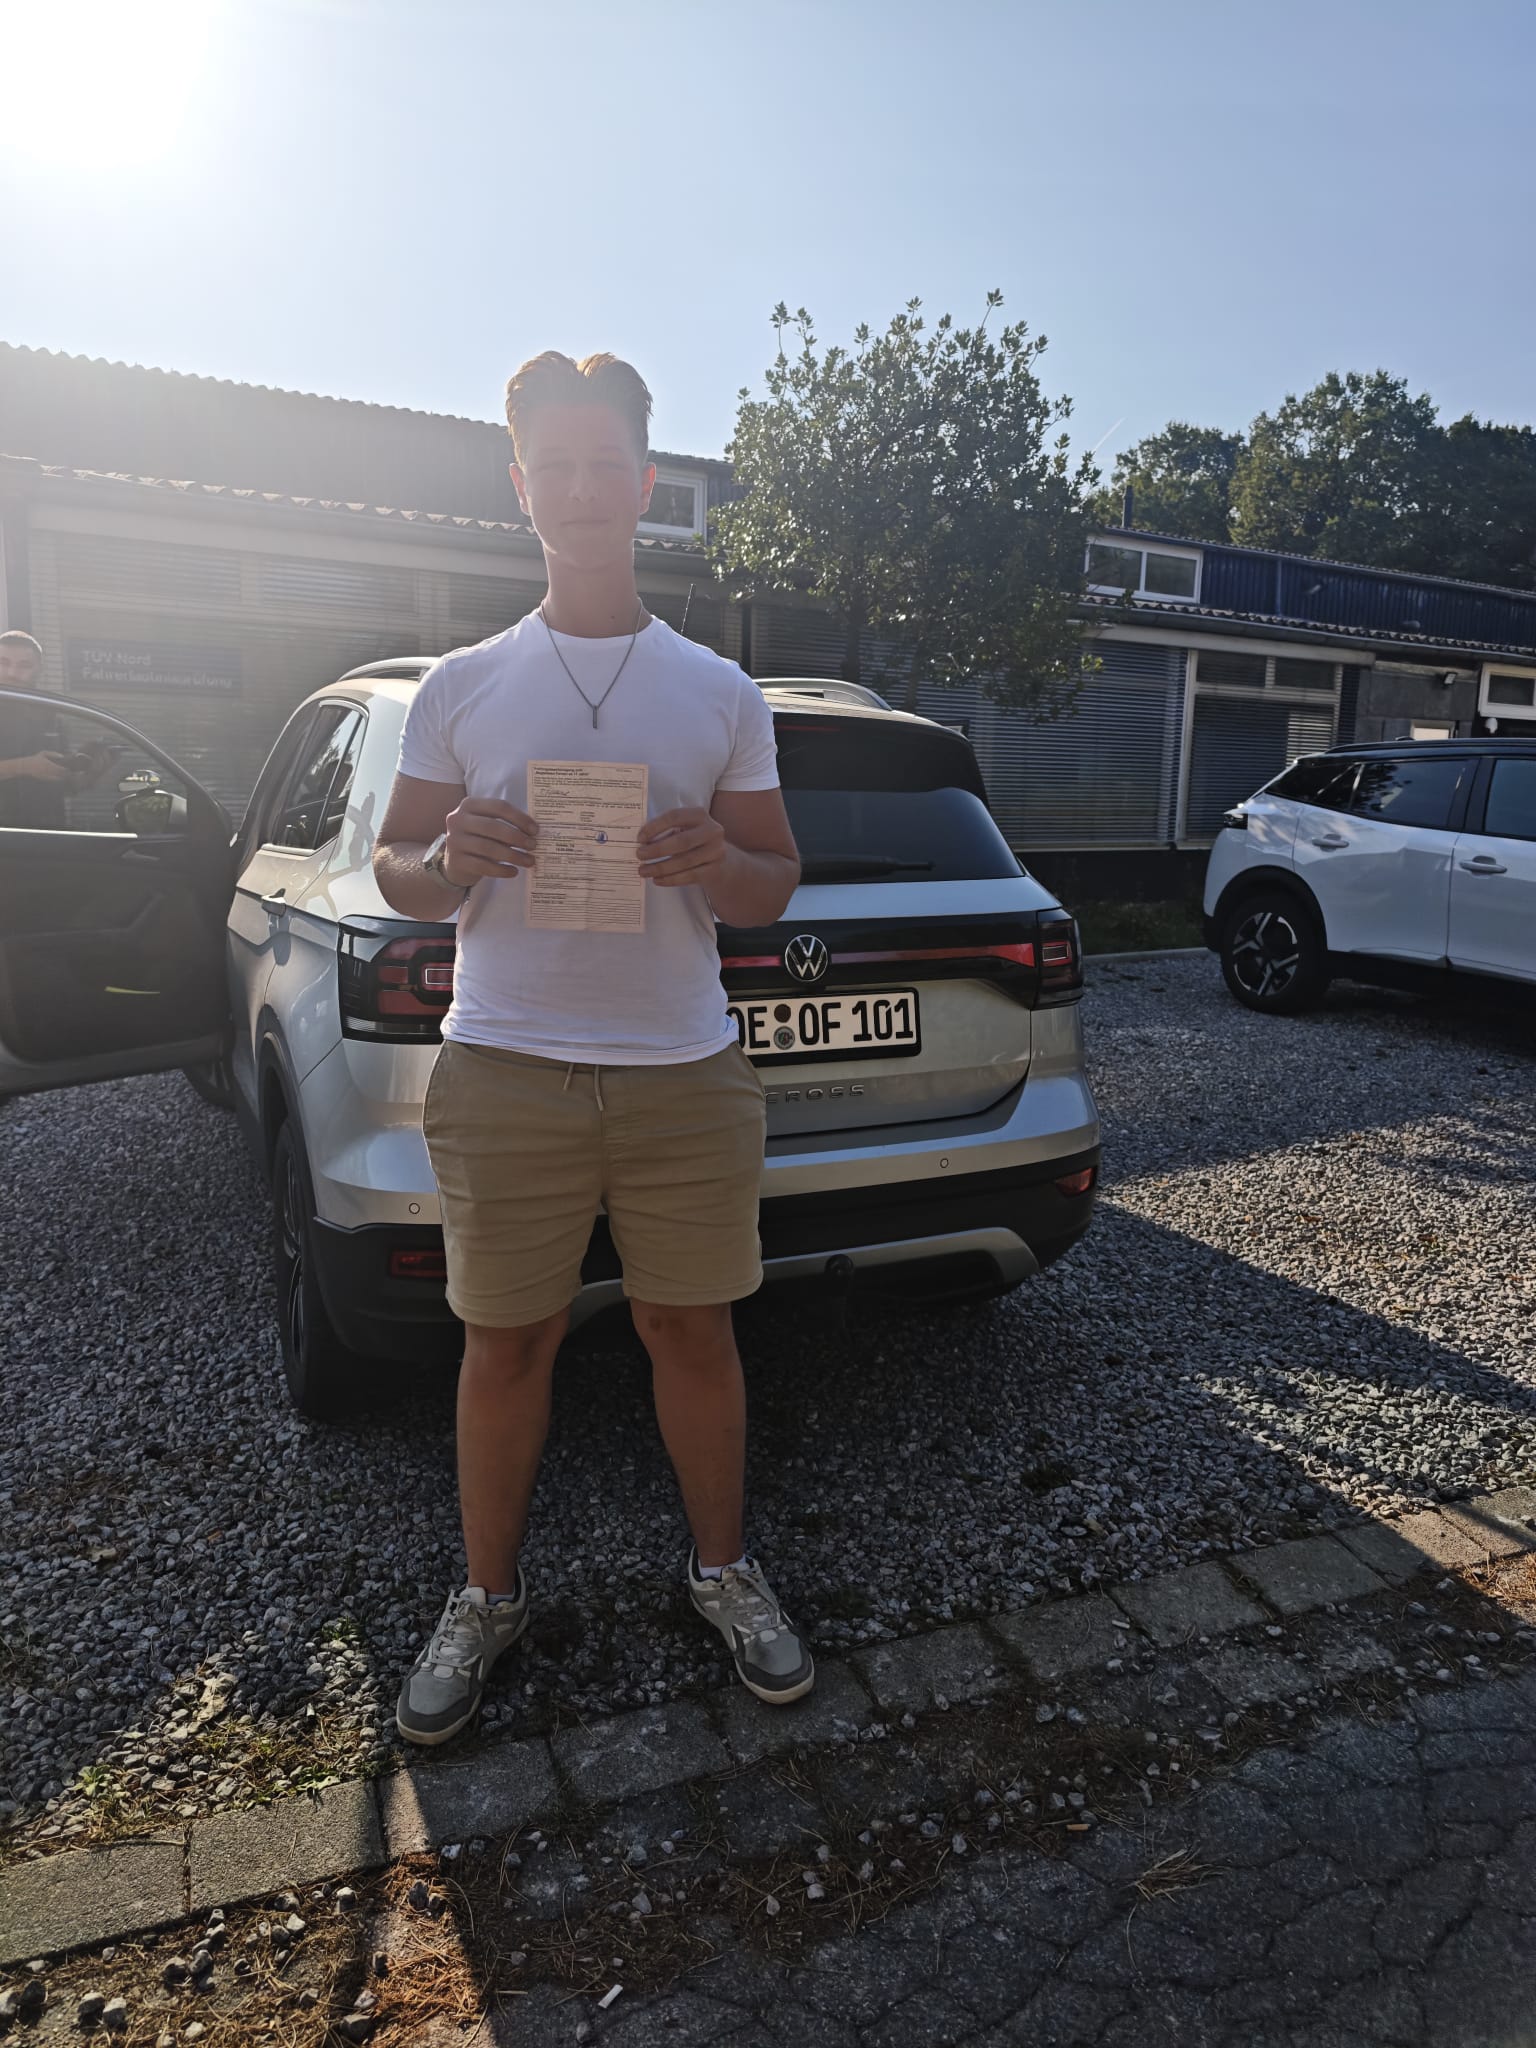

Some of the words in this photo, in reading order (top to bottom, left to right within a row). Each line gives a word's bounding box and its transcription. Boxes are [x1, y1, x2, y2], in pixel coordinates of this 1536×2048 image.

[798, 1002, 841, 1046] OF
[851, 998, 915, 1042] 101
[765, 1084, 865, 1104] CROSS
